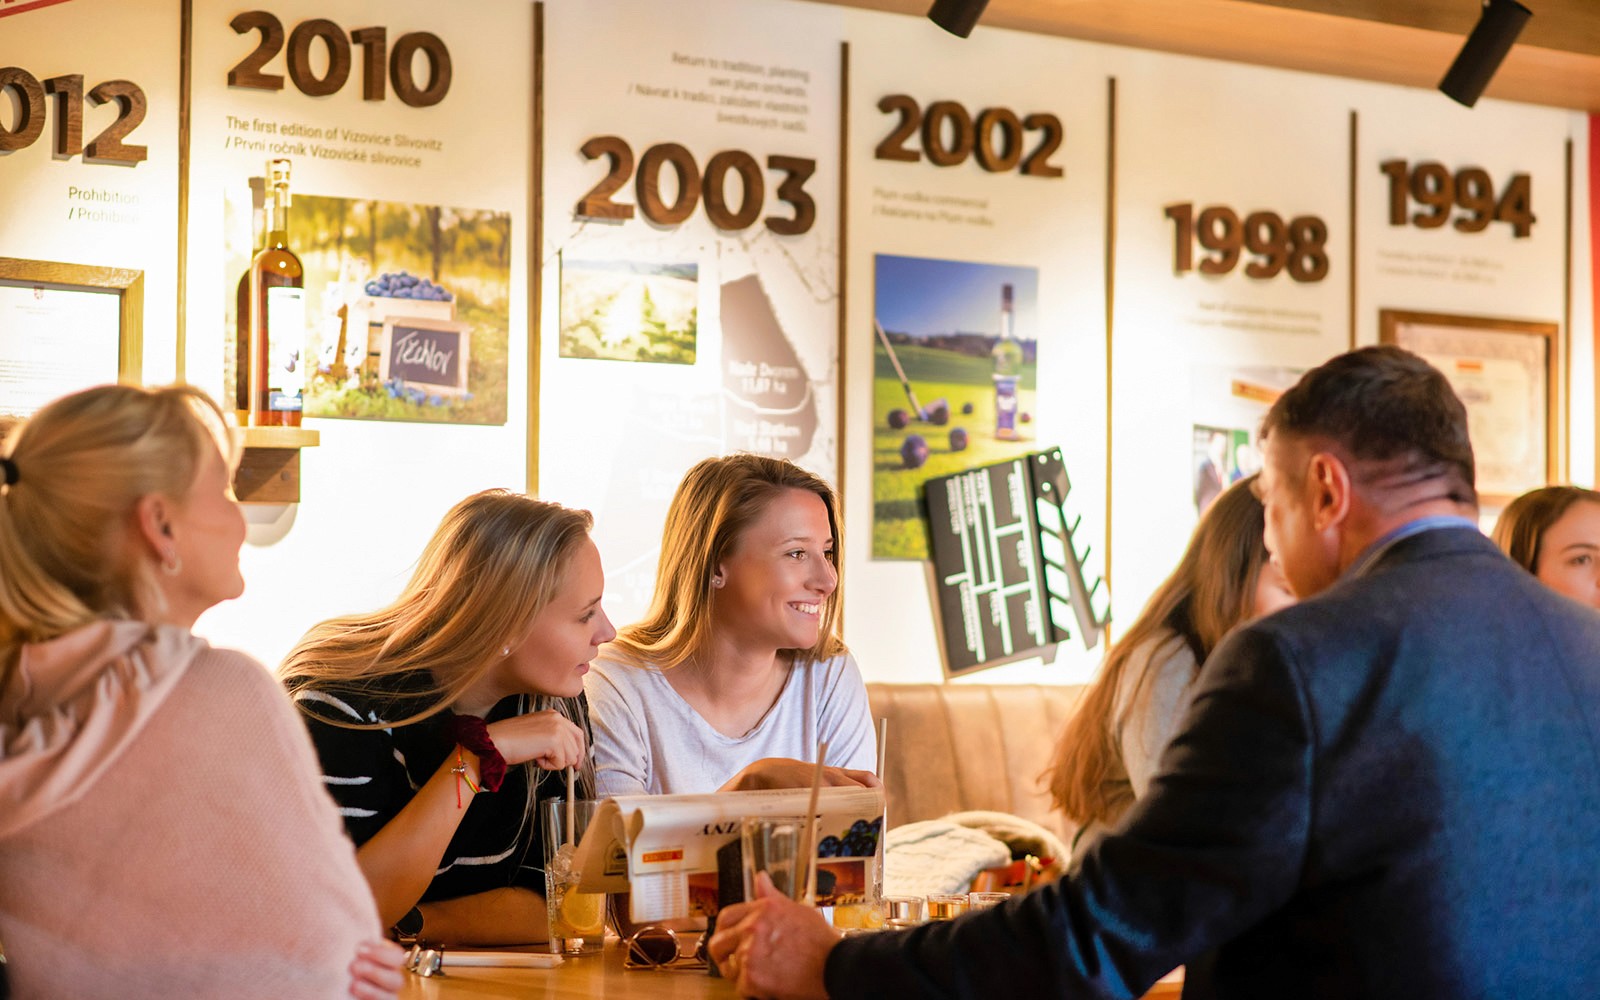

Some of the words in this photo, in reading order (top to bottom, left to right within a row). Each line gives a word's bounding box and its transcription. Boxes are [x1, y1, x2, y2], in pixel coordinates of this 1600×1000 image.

[227, 11, 452, 107] 2010
[226, 116, 249, 131] The
[253, 118, 277, 133] first
[280, 122, 322, 137] edition
[325, 127, 338, 140] of
[342, 130, 391, 146] Vizovice
[394, 134, 443, 151] Slivovitz
[234, 137, 266, 151] První
[371, 152, 422, 167] slivovice
[874, 94, 1063, 178] 2002
[68, 186, 141, 204] Prohibition
[576, 135, 816, 235] 2003
[1380, 159, 1536, 238] 1994
[1164, 203, 1329, 282] 1998
